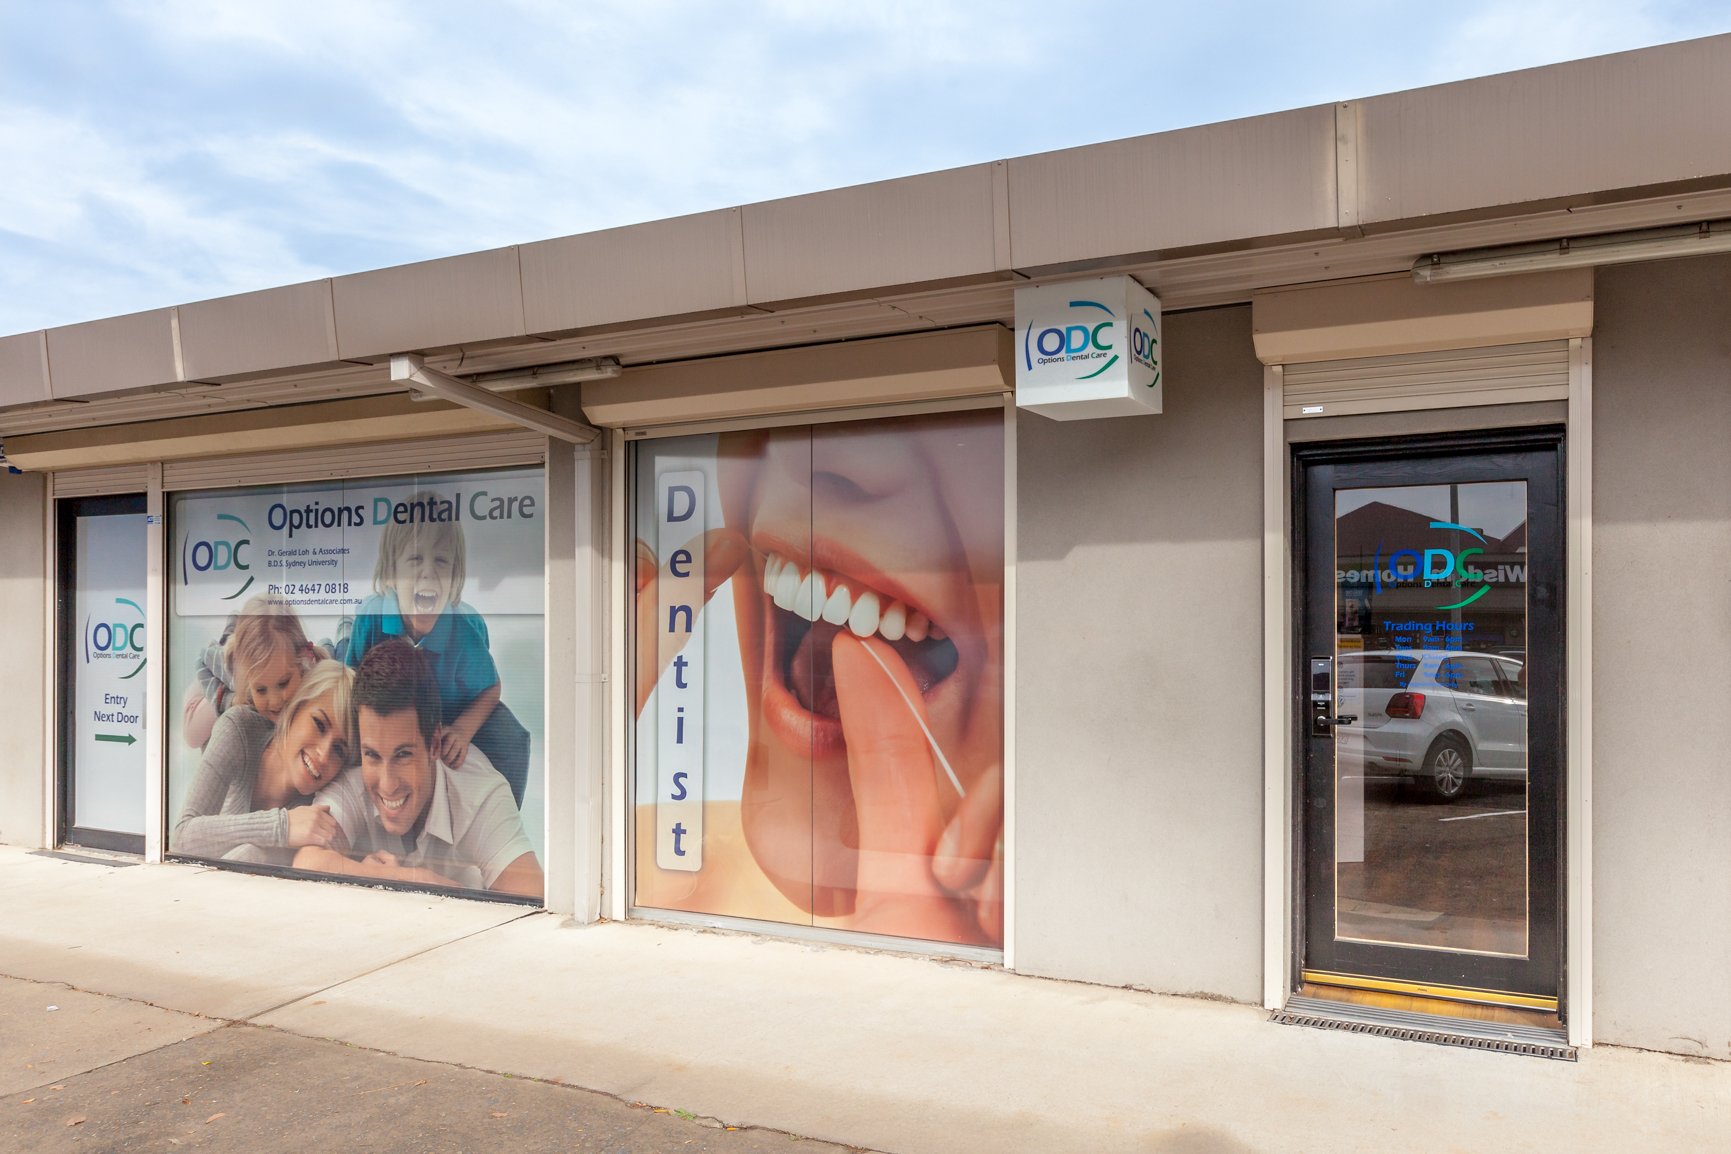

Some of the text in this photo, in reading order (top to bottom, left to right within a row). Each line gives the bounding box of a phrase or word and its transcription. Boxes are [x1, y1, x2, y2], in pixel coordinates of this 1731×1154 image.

[1037, 322, 1113, 356] ODC
[1133, 327, 1158, 366] ODC
[1037, 356, 1065, 366] Options
[1066, 353, 1090, 362] Dental
[267, 491, 535, 538] Options Dental Care
[191, 540, 251, 572] ODC
[268, 549, 277, 557] Dr.
[278, 548, 297, 557] Gerald
[298, 548, 310, 556] Loh
[318, 547, 350, 555] Associates
[285, 559, 307, 569] Sydney
[307, 558, 338, 568] University
[1388, 548, 1484, 580] ODC
[268, 582, 349, 595] Ph: 02 4647 0818
[1388, 580, 1422, 589] Options
[1455, 579, 1475, 588] Care
[268, 598, 362, 607] www.optionsdentalcare.com.au
[1383, 620, 1475, 634] Trading Hours
[93, 622, 145, 652] ODC
[1445, 644, 1462, 652] 6pm
[93, 651, 140, 660] Options Dental Care
[666, 485, 697, 857] Dentist
[104, 693, 128, 708] Entry
[94, 711, 139, 724] Next Door
